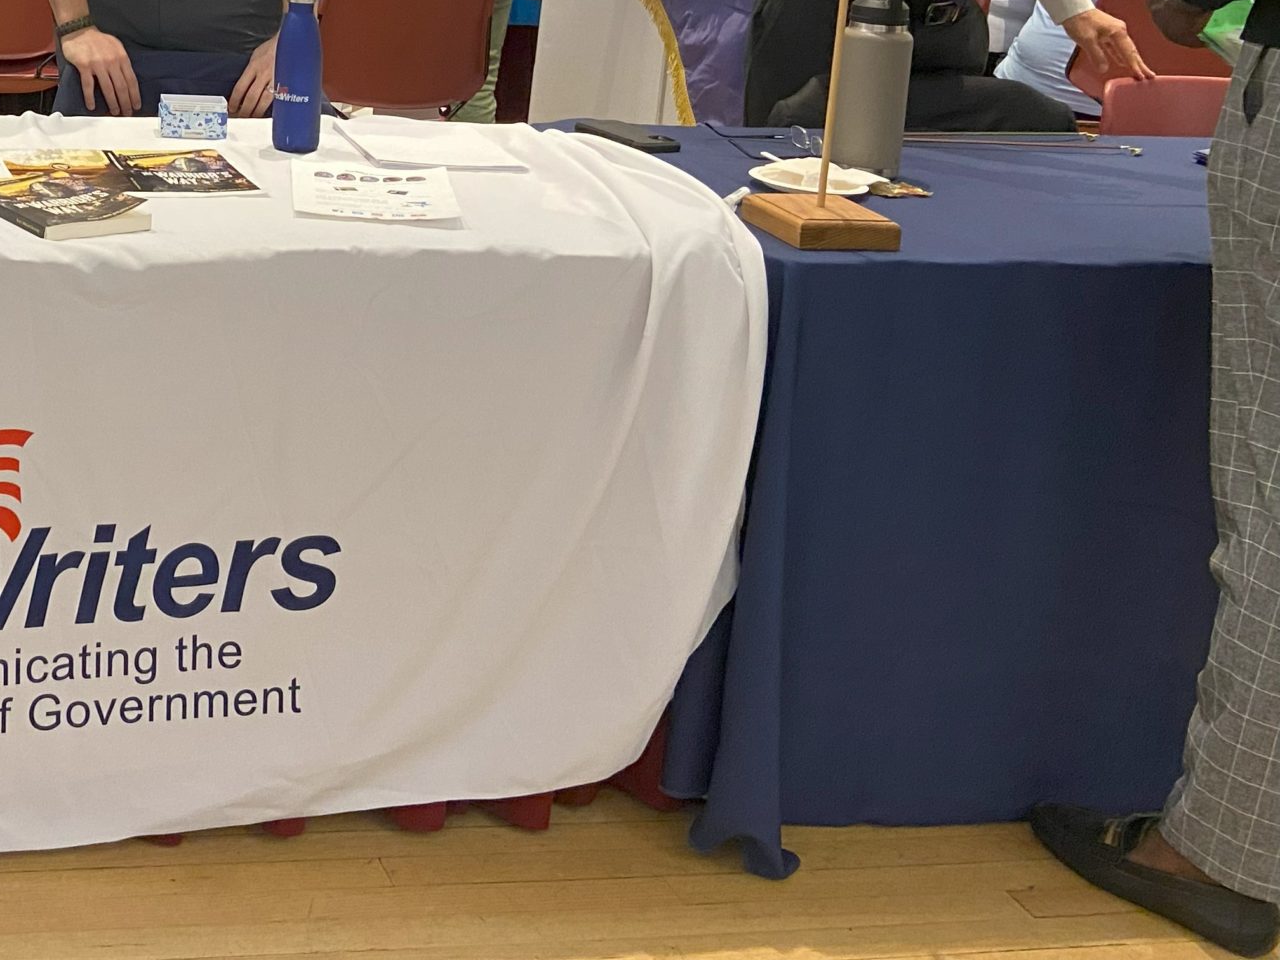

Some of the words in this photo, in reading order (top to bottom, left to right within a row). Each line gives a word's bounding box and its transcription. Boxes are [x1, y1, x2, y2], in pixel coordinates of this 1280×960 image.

[164, 177, 199, 185] WAY
[42, 205, 83, 215] WAY
[175, 634, 242, 672] the
[28, 677, 302, 731] Government
